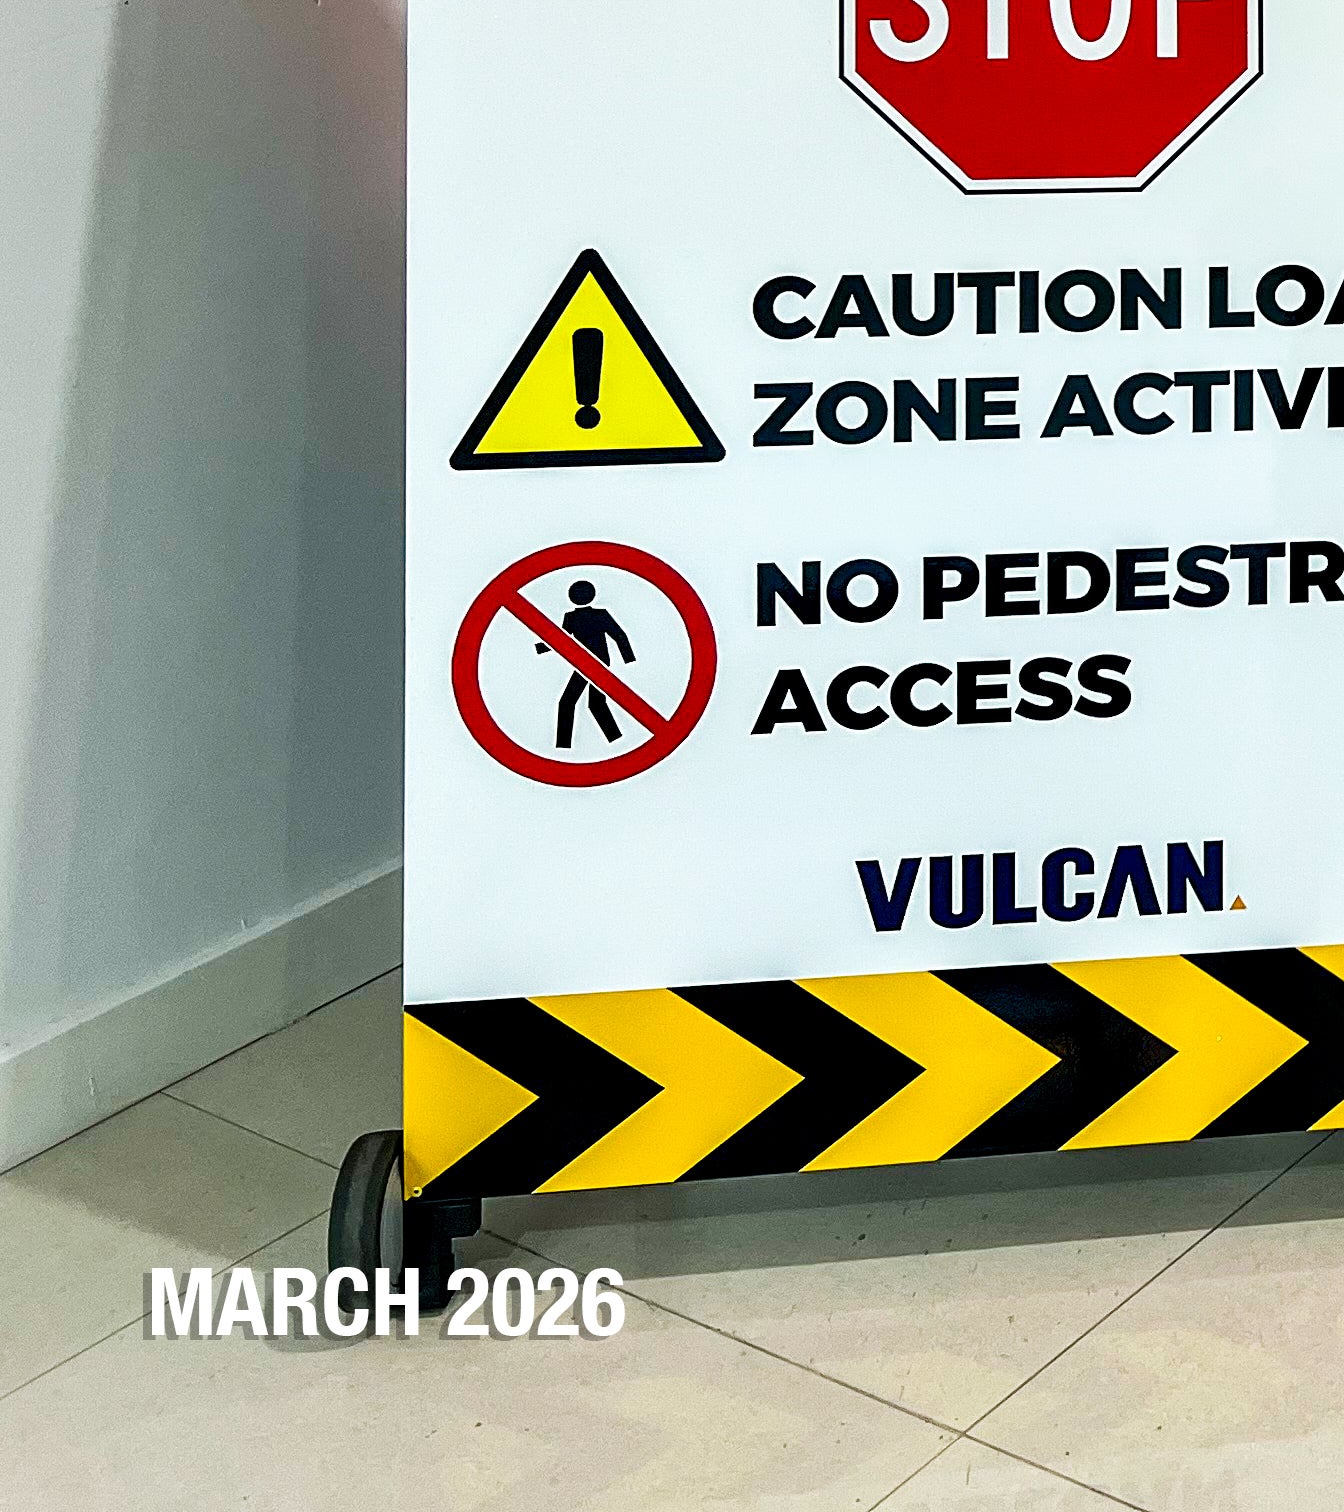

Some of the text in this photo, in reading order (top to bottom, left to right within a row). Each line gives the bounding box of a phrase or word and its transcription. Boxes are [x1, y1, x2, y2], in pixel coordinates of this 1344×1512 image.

[753, 268, 1181, 339] CAUTION
[753, 377, 1020, 447] ZONE
[757, 559, 898, 626] NO
[751, 655, 1131, 735] ACCESS
[855, 840, 1223, 932] VULCAN
